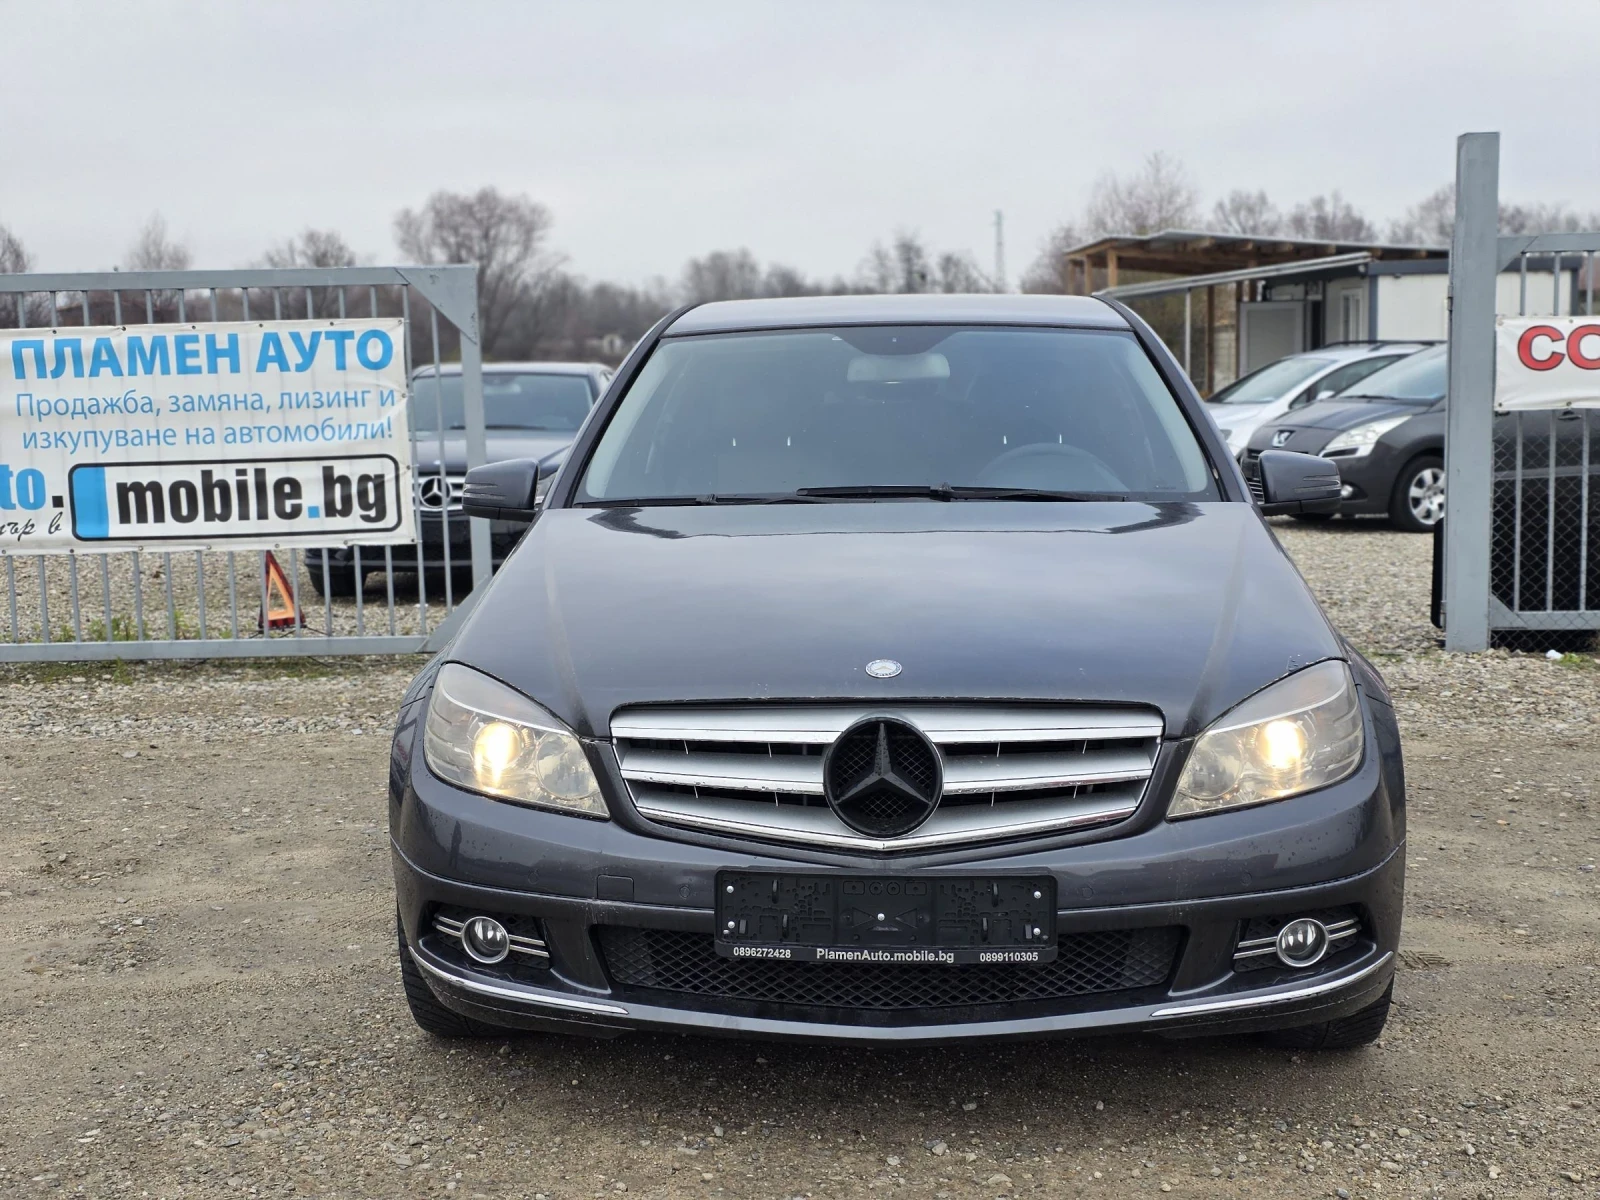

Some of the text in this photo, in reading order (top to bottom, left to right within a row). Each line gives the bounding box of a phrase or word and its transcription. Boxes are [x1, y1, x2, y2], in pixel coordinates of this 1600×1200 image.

[11, 329, 394, 380] ПЛАМЕН АУТО
[16, 387, 395, 421] Продажба, замяна, лизинг и
[22, 417, 393, 455] изкупуване на автомобили!
[116, 465, 388, 525] mobile.bg
[733, 947, 1039, 963] 0896272428 PlamenAuto.mobile.bg 0899110305
